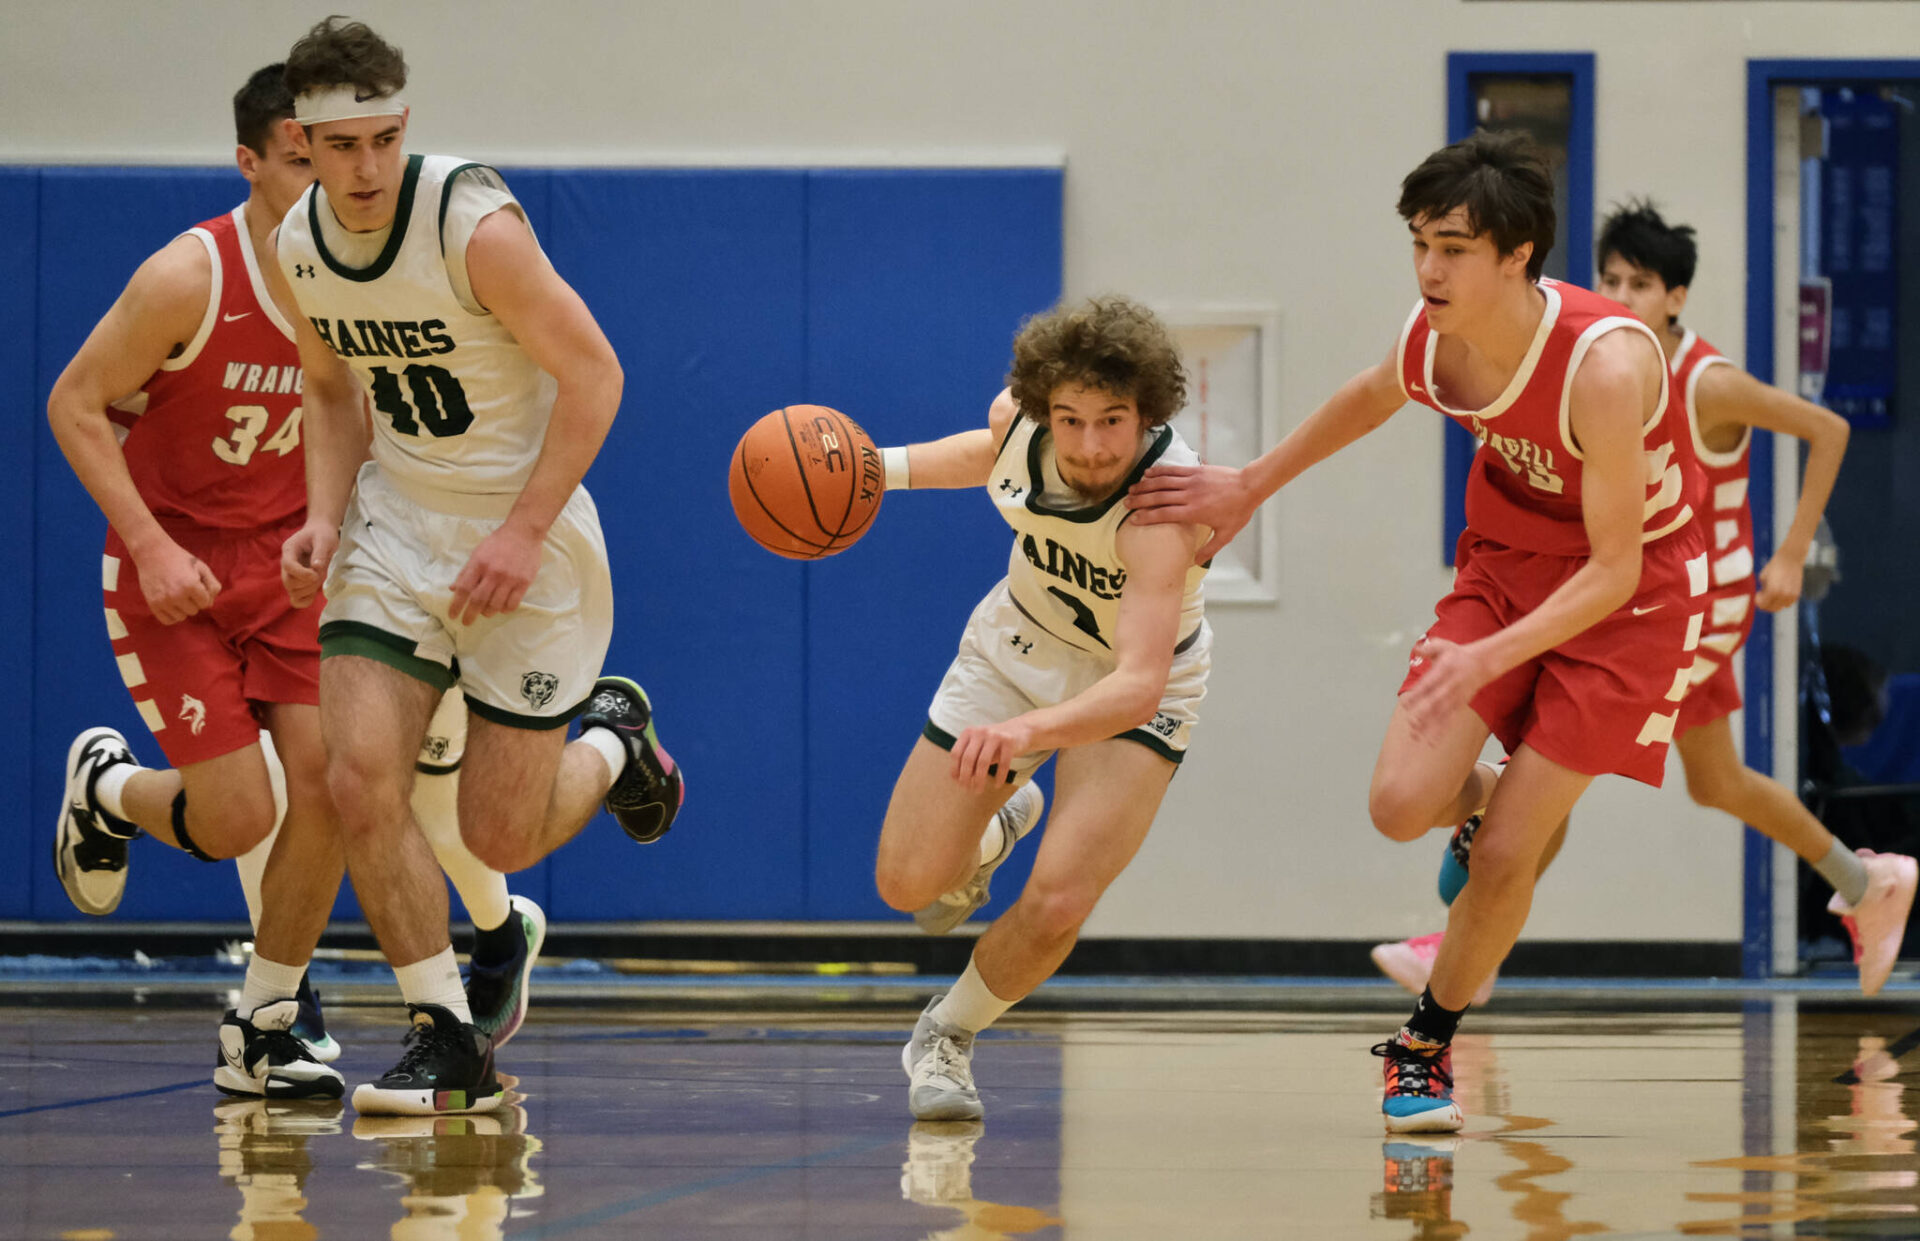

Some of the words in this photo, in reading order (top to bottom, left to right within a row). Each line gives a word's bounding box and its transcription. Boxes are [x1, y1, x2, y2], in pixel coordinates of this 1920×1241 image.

[309, 316, 457, 358] HAINES
[368, 363, 475, 438] 10
[211, 404, 304, 467] 34
[860, 446, 881, 505] ROCK
[1013, 529, 1127, 600] AINES
